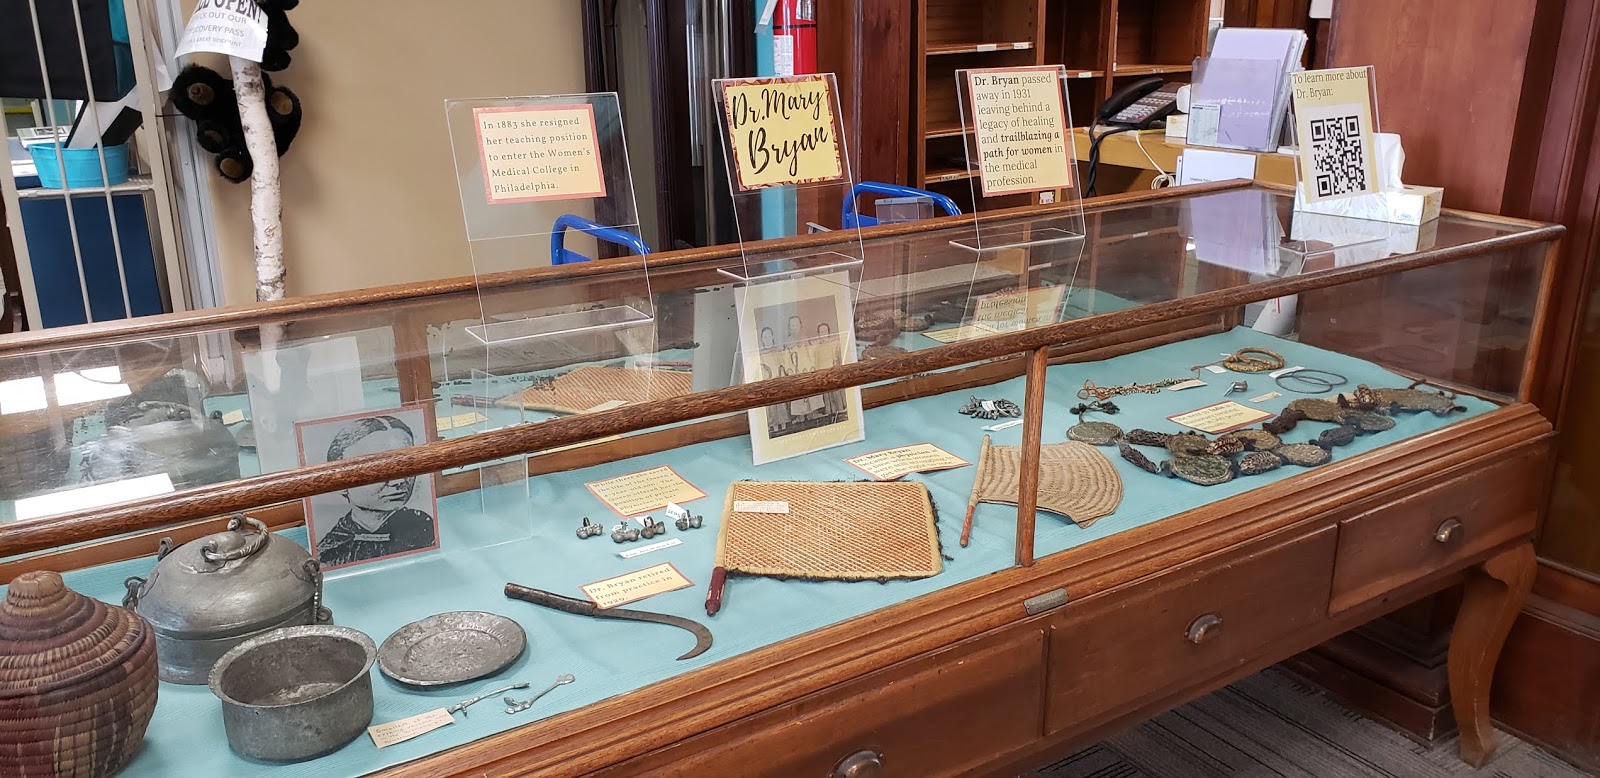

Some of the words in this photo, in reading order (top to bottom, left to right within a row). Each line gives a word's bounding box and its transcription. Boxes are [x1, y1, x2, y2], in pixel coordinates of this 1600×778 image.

[228, 14, 246, 24] OUR
[224, 27, 244, 37] PASS
[975, 76, 989, 86] Dr.
[992, 76, 1019, 87] Bryan
[1022, 74, 1052, 86] passed
[1293, 74, 1302, 84] To
[1305, 73, 1323, 83] learn
[1326, 72, 1344, 82] more
[1346, 69, 1366, 79] about
[976, 92, 999, 102] away
[1002, 90, 1010, 99] in
[1013, 89, 1031, 98] 1931
[1297, 89, 1308, 99] Dr.
[1310, 88, 1333, 100] Bryan:
[978, 105, 1010, 116] leaving
[1012, 102, 1043, 113] behind
[498, 121, 518, 129] 1883
[521, 119, 536, 128] she
[540, 118, 579, 128] resigned
[980, 120, 1008, 131] legacy
[1011, 117, 1021, 127] of
[1022, 117, 1054, 127] healing
[486, 137, 502, 145] her
[505, 134, 546, 145] teaching
[550, 133, 588, 143] position
[982, 135, 998, 144] and
[1001, 131, 1052, 143] trailblazing
[502, 152, 526, 161] enter
[530, 151, 545, 159] the
[548, 148, 590, 157] Women's
[748, 127, 828, 177] Bryan
[983, 148, 1004, 161] path
[1006, 147, 1019, 159] for
[1021, 145, 1052, 155] women
[1055, 144, 1063, 153] in
[492, 167, 530, 177] Medical
[533, 165, 567, 175] College
[570, 164, 580, 172] in
[985, 164, 1000, 173] the
[1003, 160, 1037, 171] medical
[494, 182, 558, 193] Philadelphia.
[987, 175, 1037, 190] profession.
[593, 479, 614, 488] While
[615, 475, 634, 483] there
[614, 497, 643, 506] position
[654, 488, 679, 497] private
[620, 500, 655, 511] physician
[607, 578, 636, 588] Bryan
[638, 567, 670, 580] retired
[595, 592, 620, 600] from
[623, 579, 660, 593] practice
